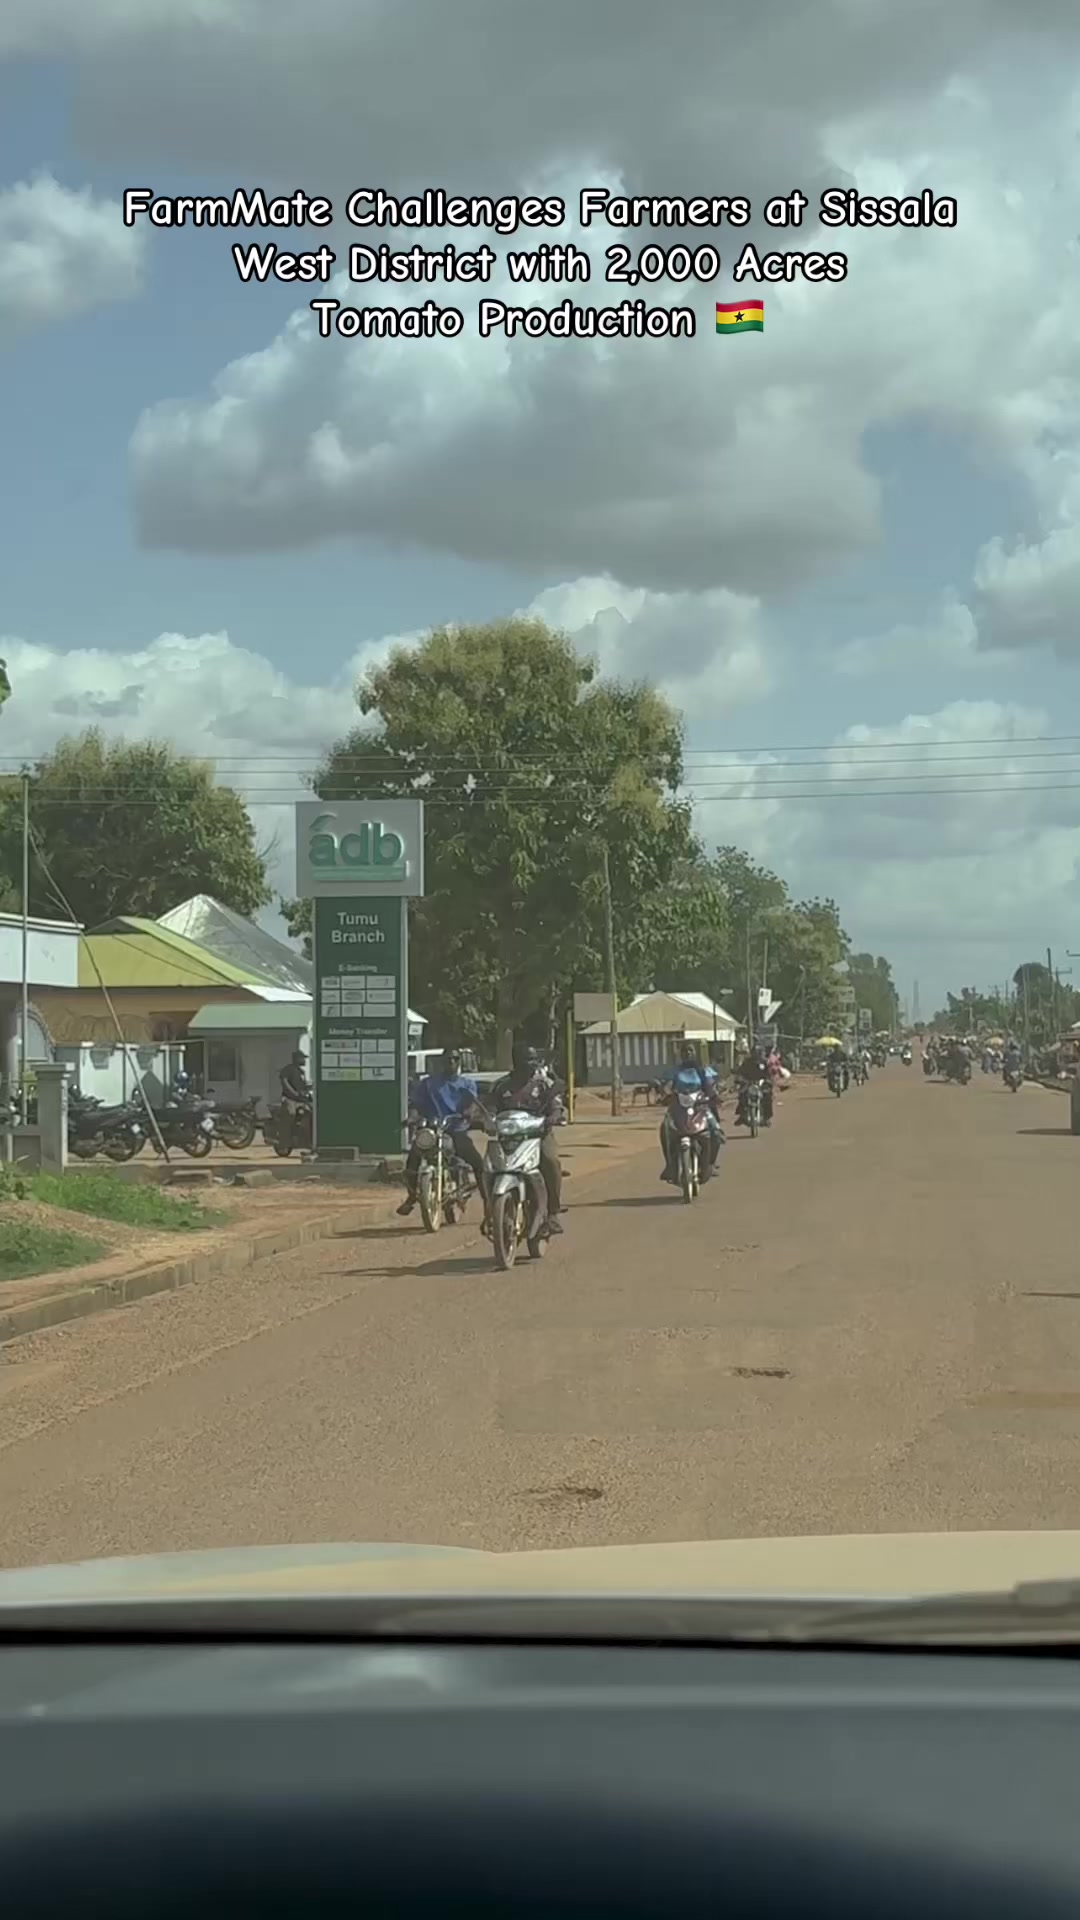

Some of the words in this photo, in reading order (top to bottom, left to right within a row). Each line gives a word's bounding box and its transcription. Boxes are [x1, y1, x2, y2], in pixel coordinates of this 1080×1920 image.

[308, 820, 405, 867] adb
[337, 911, 379, 926] Tumu
[331, 929, 385, 944] Branch
